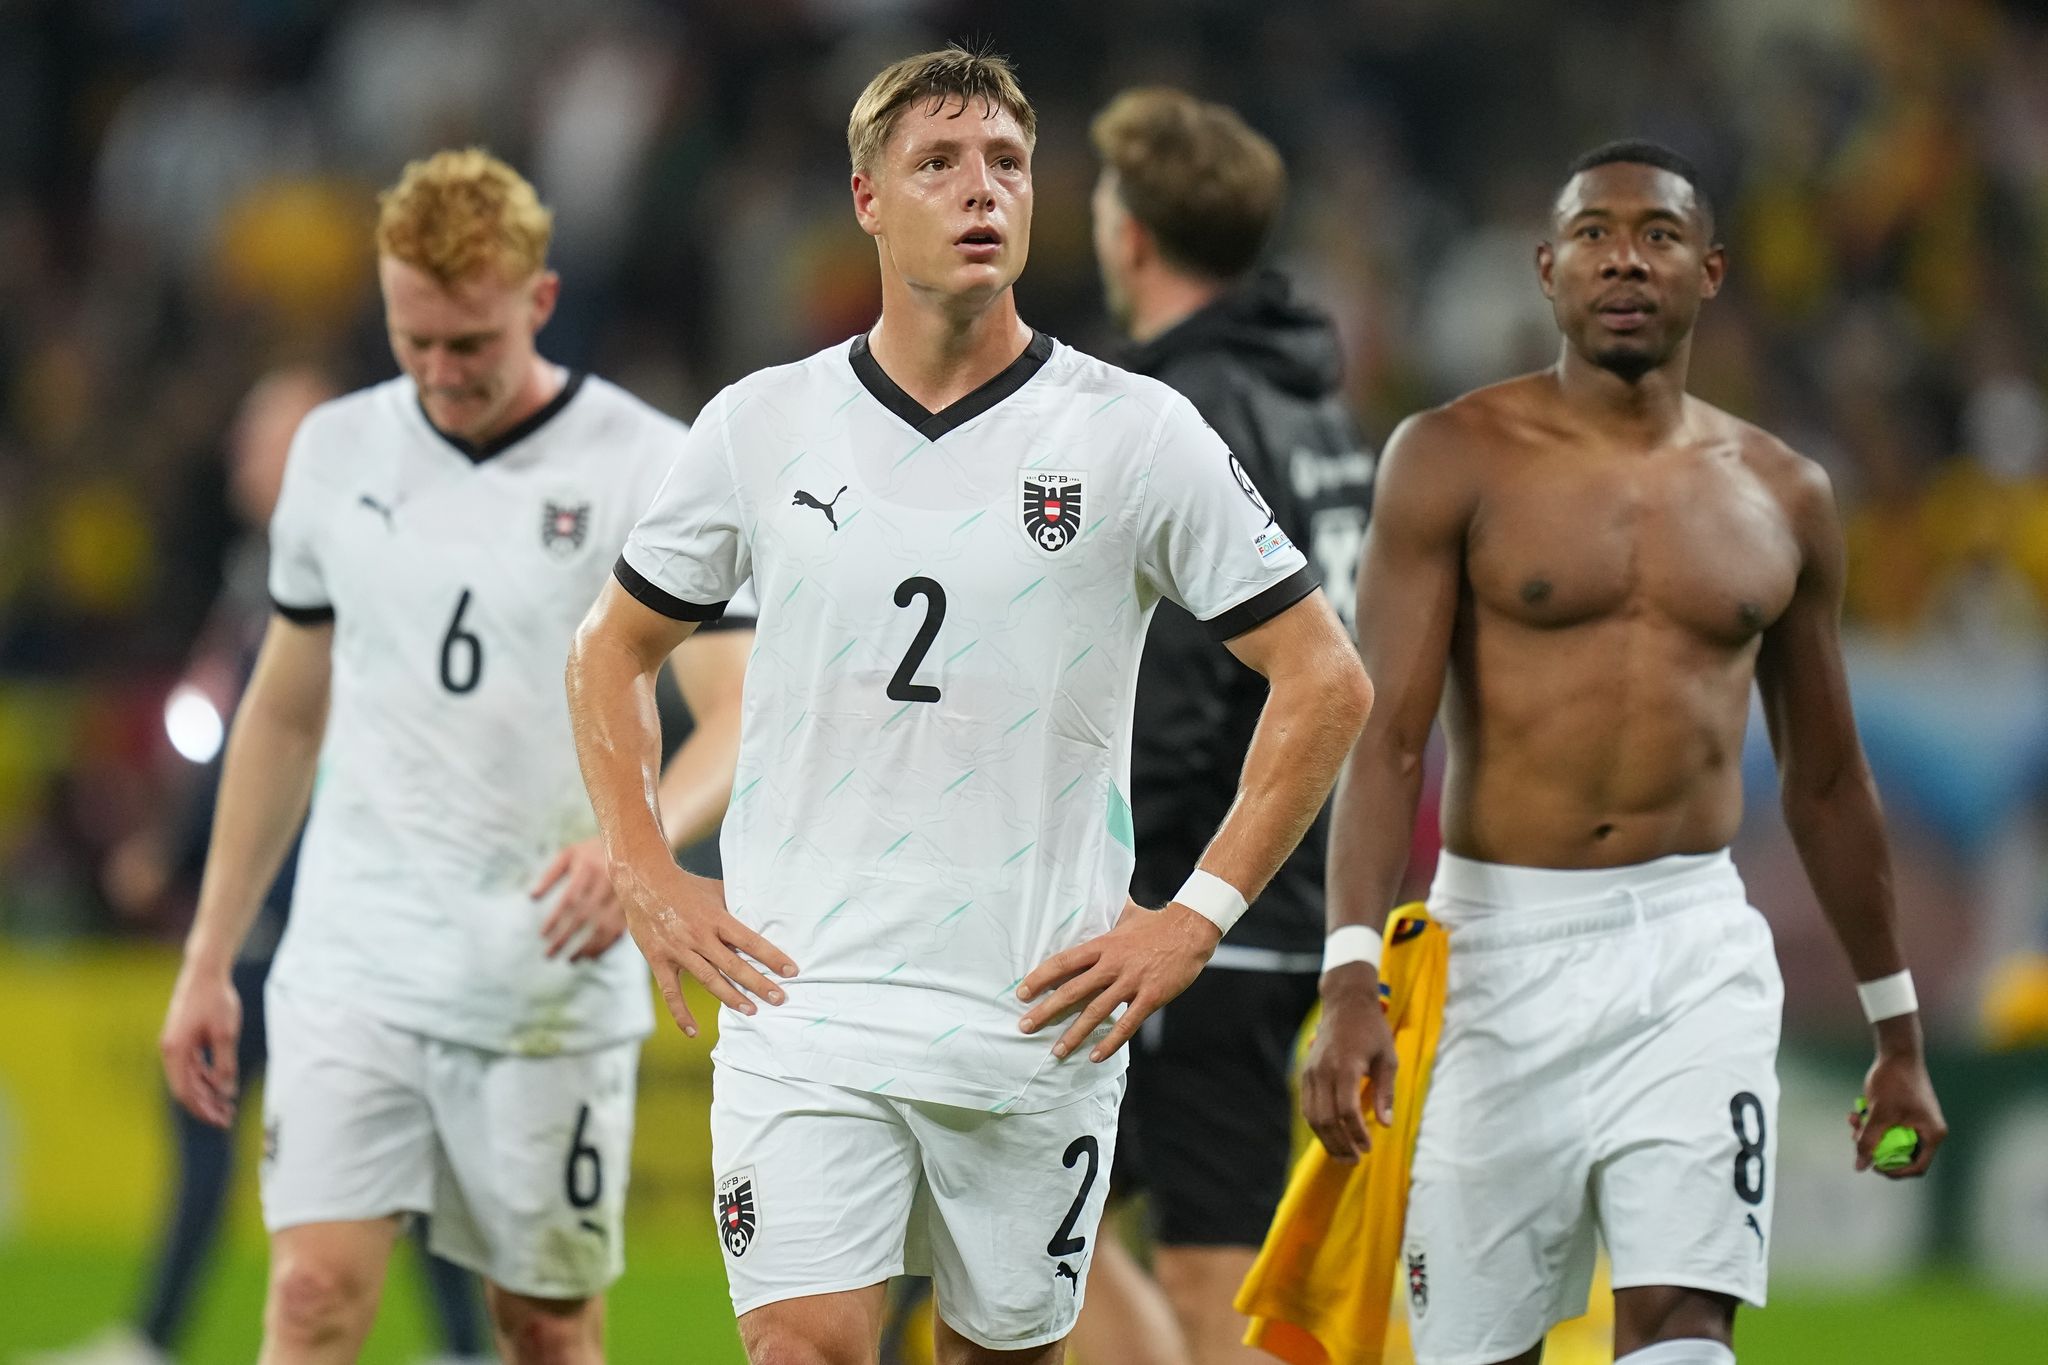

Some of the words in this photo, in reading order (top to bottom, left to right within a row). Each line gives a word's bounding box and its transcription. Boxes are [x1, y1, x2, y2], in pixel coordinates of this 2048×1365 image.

[1038, 472, 1068, 483] ÖFB
[440, 590, 482, 694] 6
[886, 576, 946, 703] 2
[563, 1104, 603, 1213] 6
[722, 1176, 738, 1190] ÖFB
[1046, 1134, 1099, 1258] 2
[1729, 1091, 1766, 1206] 8
